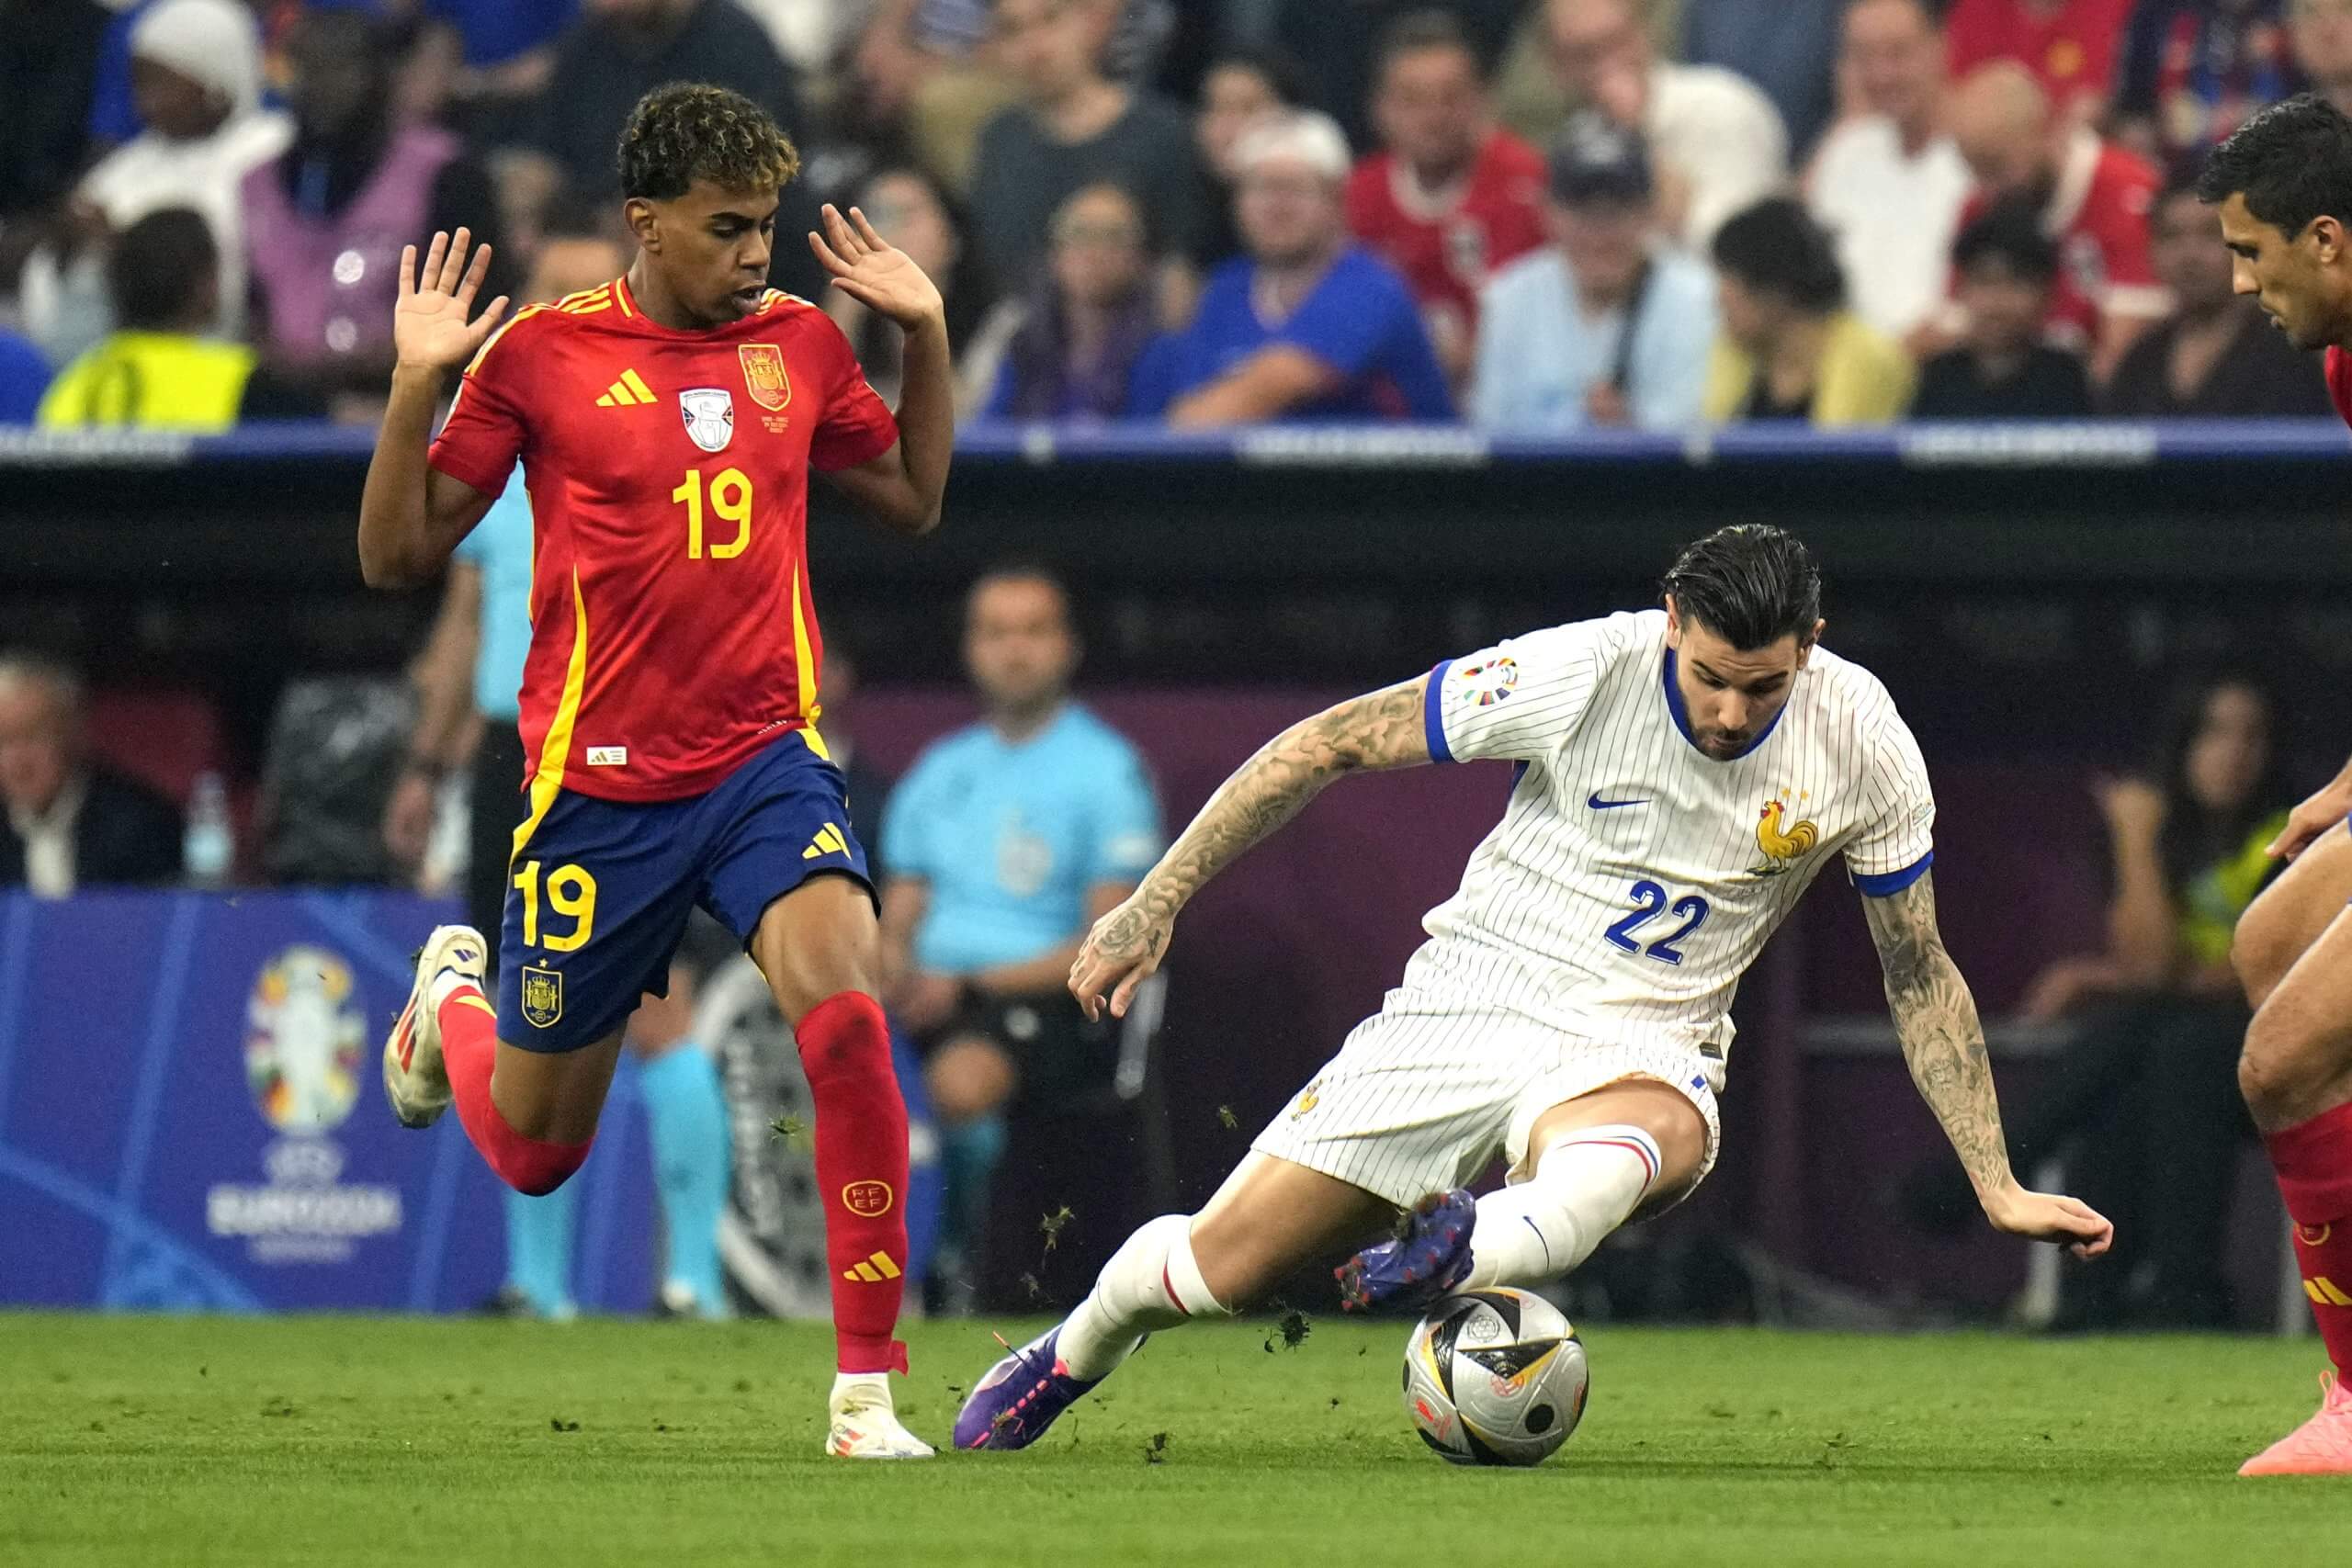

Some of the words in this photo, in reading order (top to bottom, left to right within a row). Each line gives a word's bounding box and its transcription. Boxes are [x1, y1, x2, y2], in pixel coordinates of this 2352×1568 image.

[673, 468, 752, 558] 19
[514, 860, 596, 952] 19
[1604, 880, 1710, 965] 22
